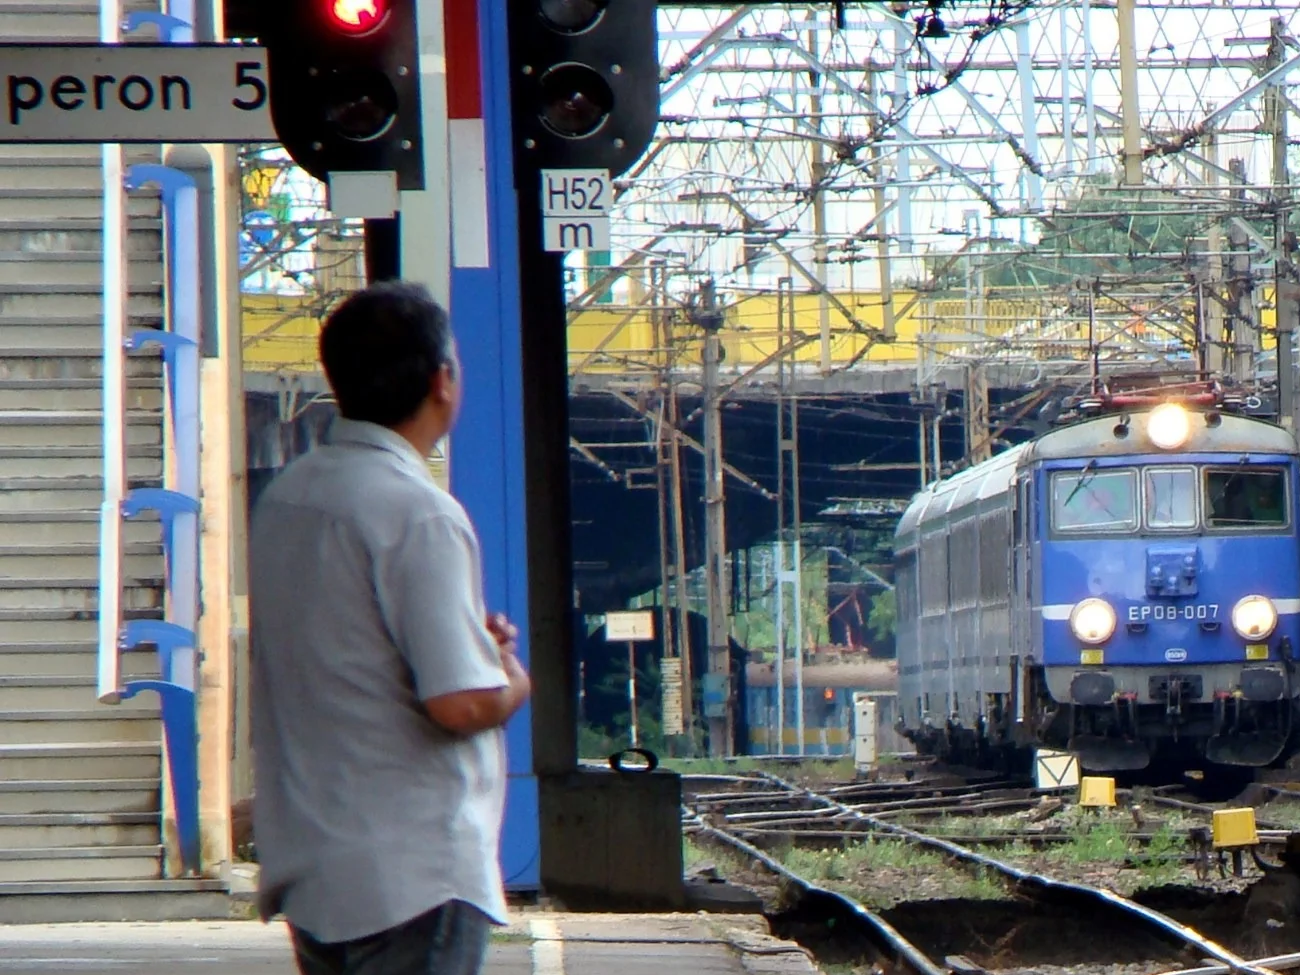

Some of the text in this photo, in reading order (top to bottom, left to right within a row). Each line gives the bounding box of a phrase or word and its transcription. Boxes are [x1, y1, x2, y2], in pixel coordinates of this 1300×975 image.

[8, 62, 267, 125] peron 5
[548, 177, 604, 210] H52
[559, 222, 593, 248] m
[1128, 604, 1219, 621] EP08-007
